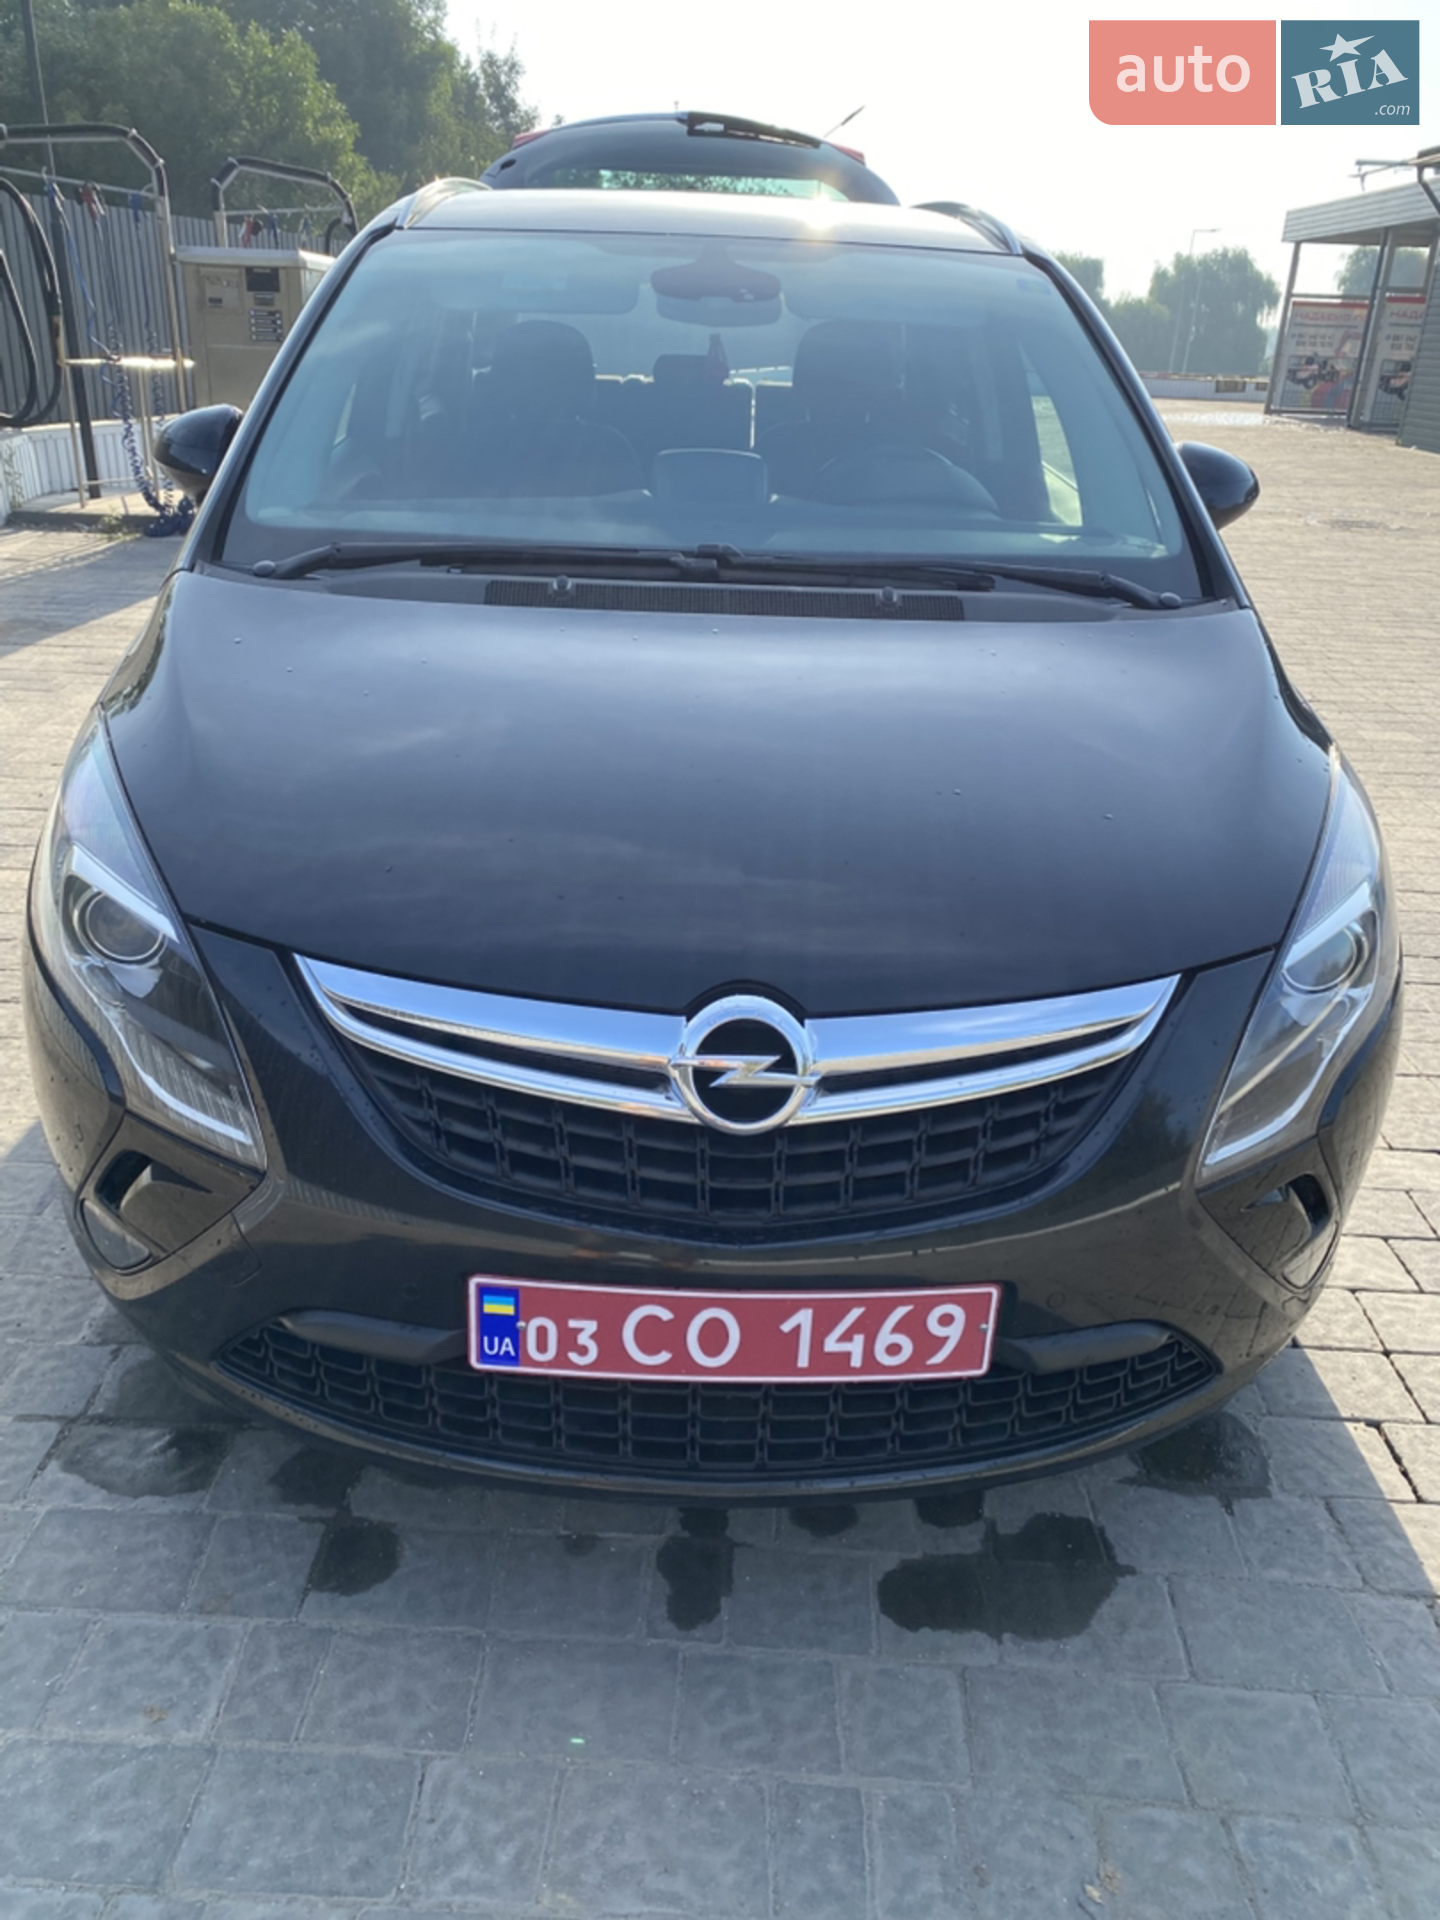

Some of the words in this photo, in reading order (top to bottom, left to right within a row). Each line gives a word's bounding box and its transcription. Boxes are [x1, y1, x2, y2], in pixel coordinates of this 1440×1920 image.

[482, 1336, 516, 1357] UA
[525, 1316, 599, 1366] 03
[622, 1304, 741, 1368] CO
[779, 1303, 967, 1369] 1469
